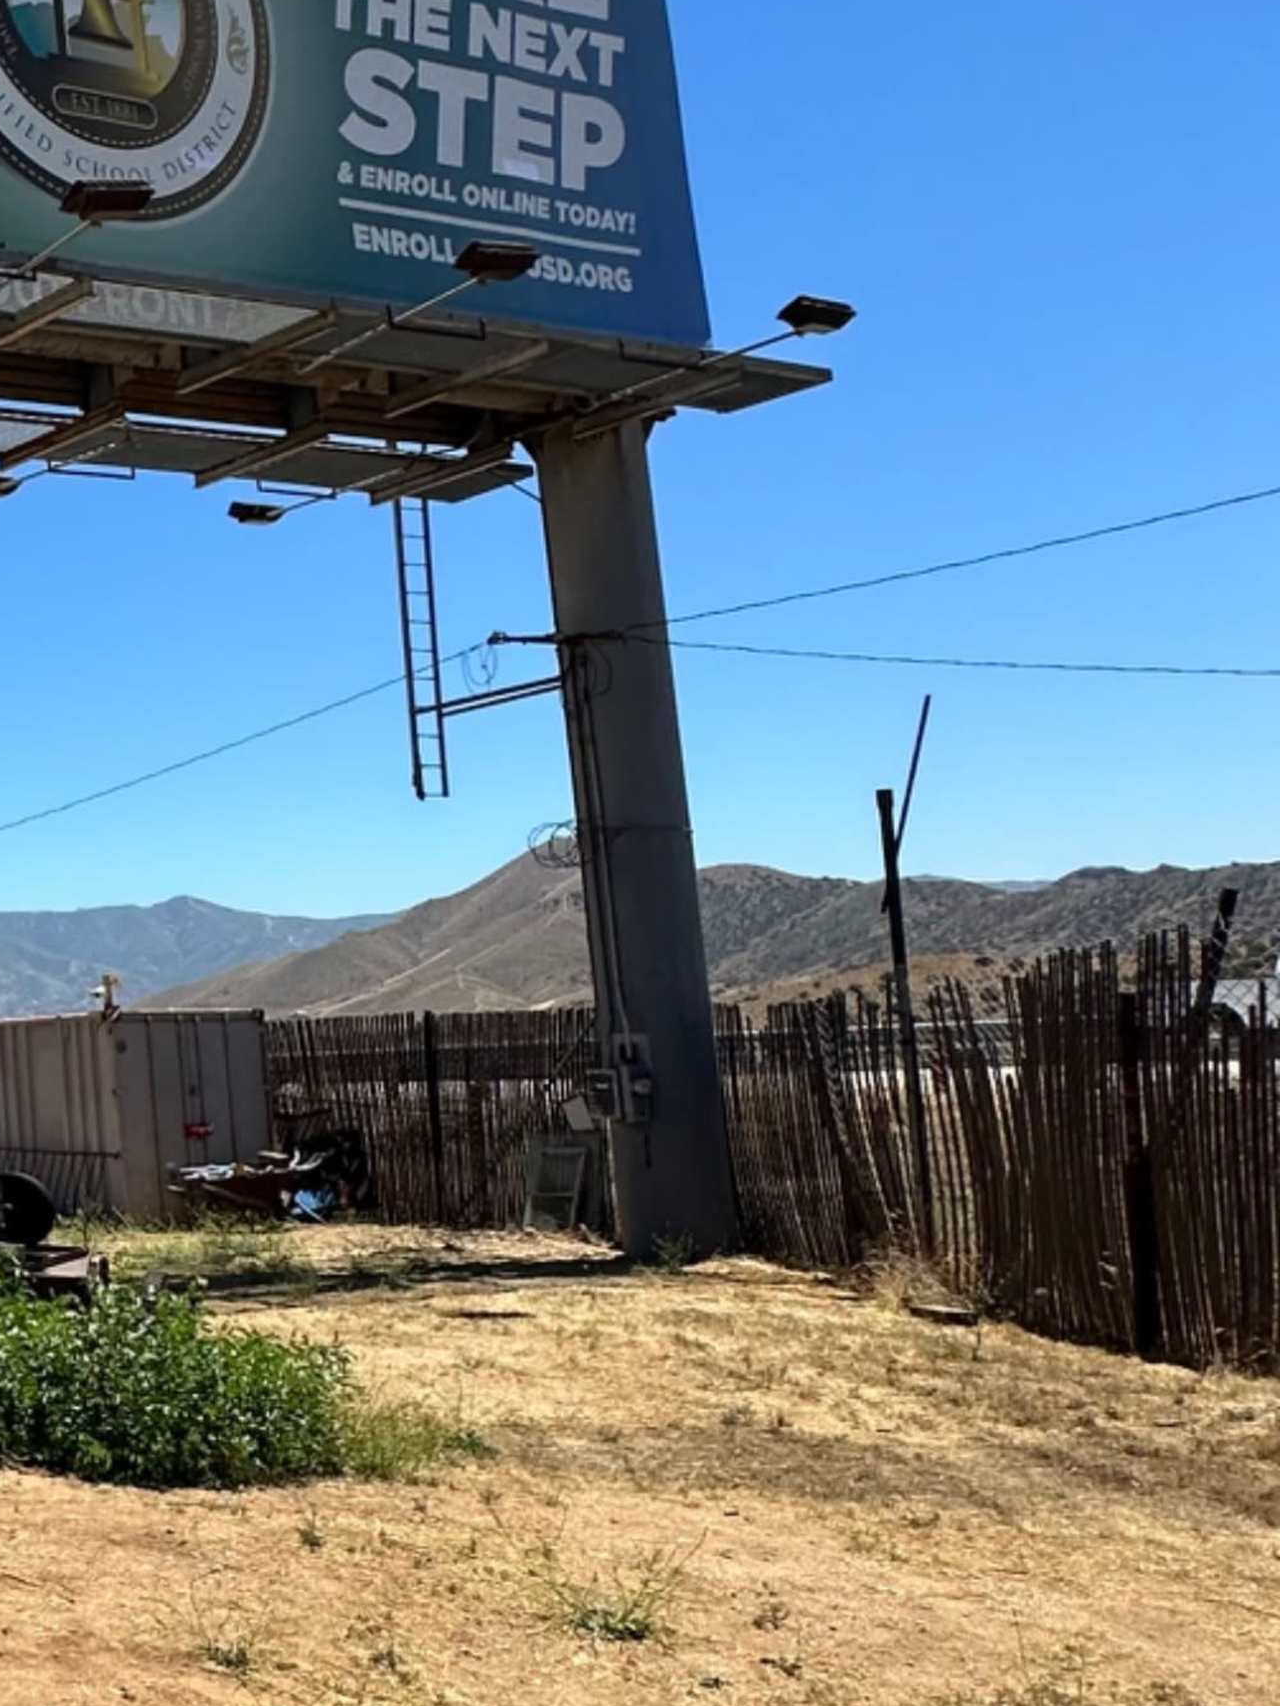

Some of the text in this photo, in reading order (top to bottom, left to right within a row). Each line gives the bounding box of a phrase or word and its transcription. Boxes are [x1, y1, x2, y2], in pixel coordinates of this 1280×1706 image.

[468, 2, 625, 88] NEXT
[163, 99, 238, 180] DISTRICT
[338, 47, 626, 192] STEP
[337, 160, 636, 234] & ENROLL ONLINE TODAY!
